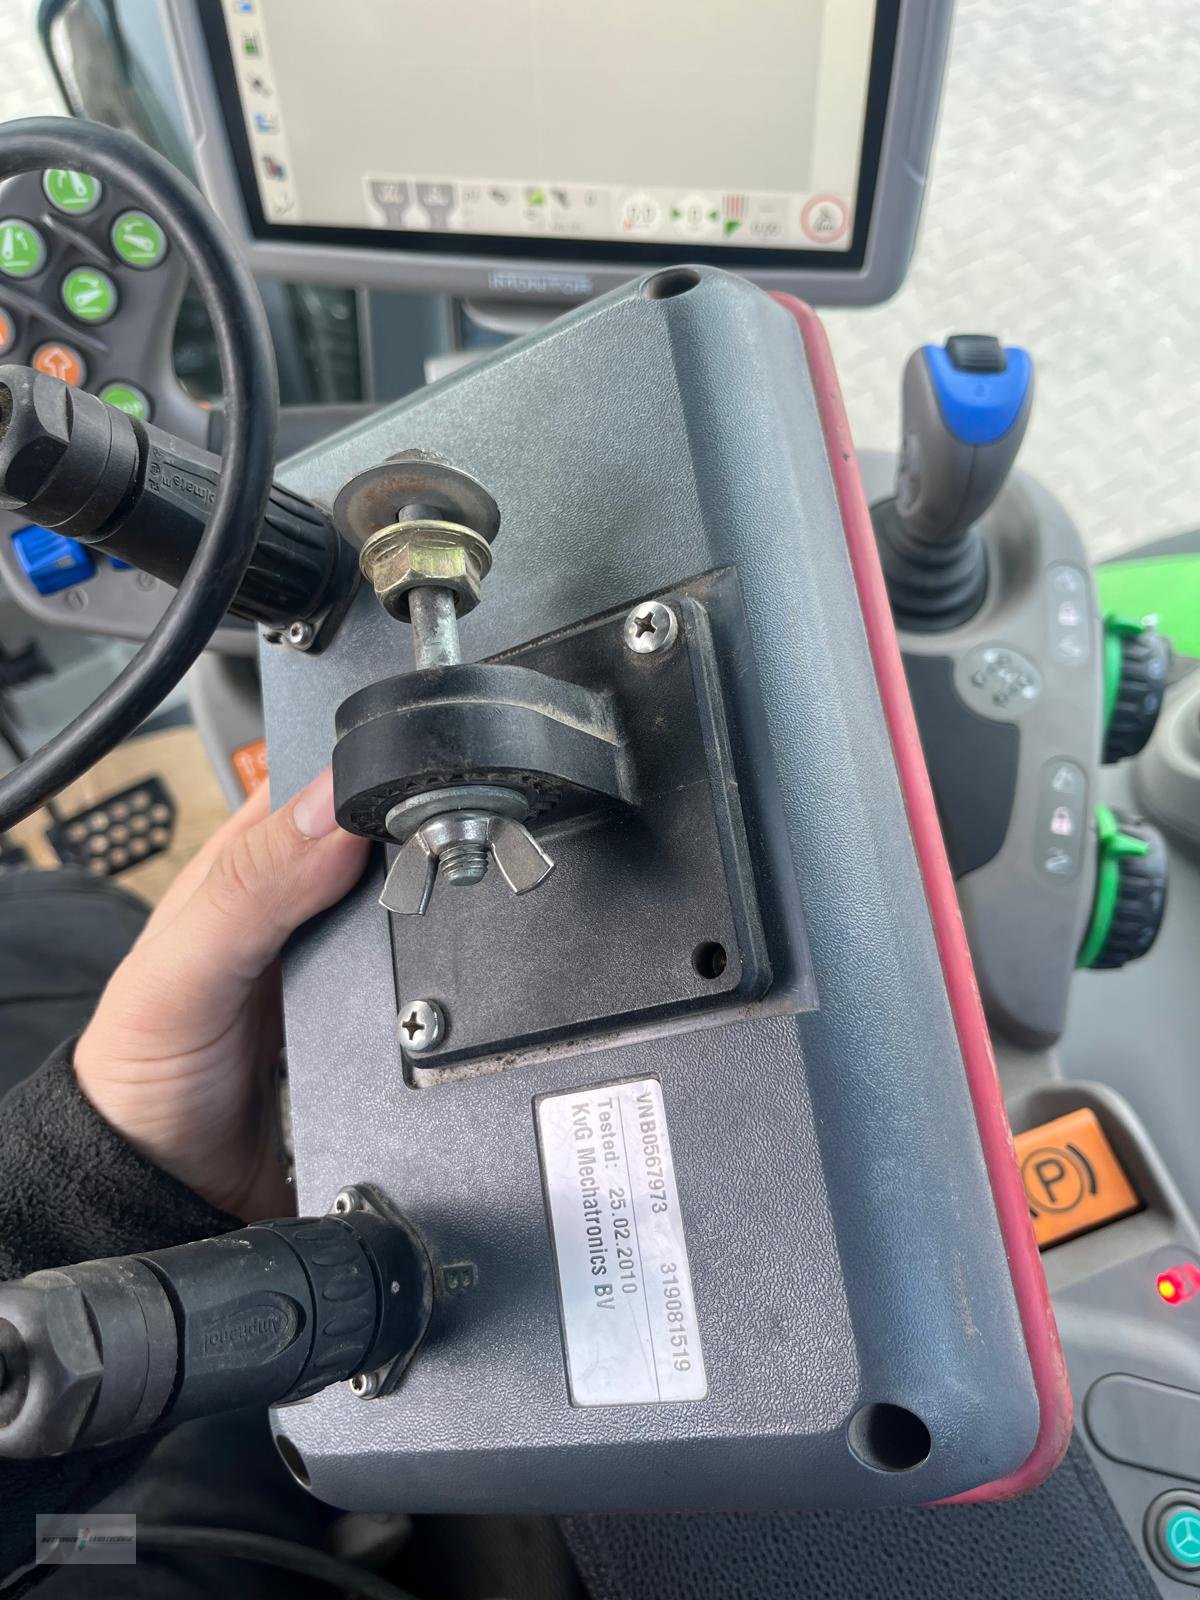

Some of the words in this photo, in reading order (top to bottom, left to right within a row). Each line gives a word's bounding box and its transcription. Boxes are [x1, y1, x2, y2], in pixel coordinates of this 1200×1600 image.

[571, 1102, 594, 1141] KvG
[597, 1097, 620, 1169] Tested:
[577, 1147, 608, 1276] Mechatronics
[1035, 1157, 1066, 1202] P
[608, 1187, 638, 1294] 25.02.2010
[636, 1091, 668, 1214] VNB0567973
[660, 1262, 692, 1372] 319081519
[594, 1283, 616, 1310] BV
